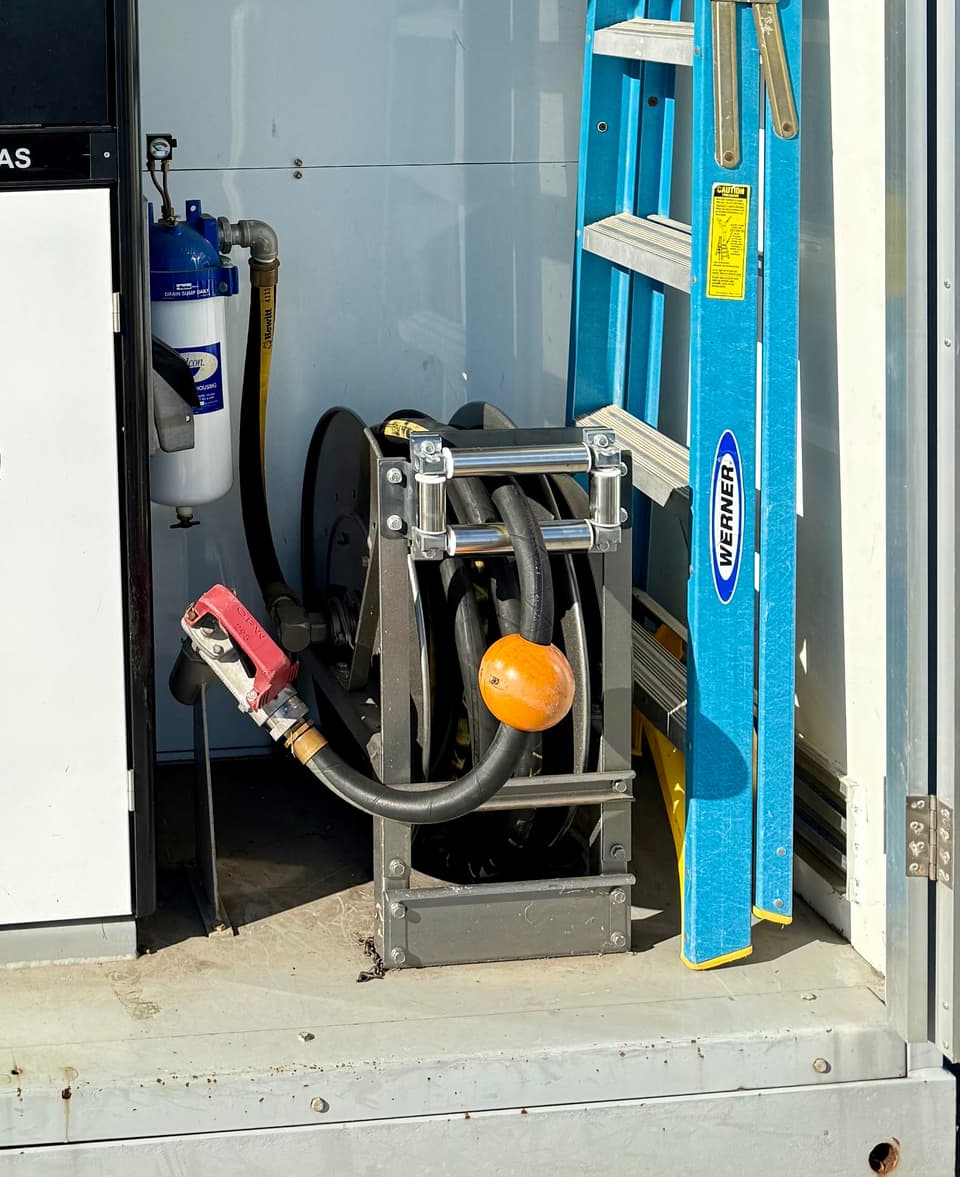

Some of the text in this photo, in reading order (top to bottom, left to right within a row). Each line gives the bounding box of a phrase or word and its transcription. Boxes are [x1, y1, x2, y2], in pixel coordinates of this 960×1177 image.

[716, 186, 745, 196] CAUTION
[264, 308, 272, 340] Hewitt
[720, 464, 734, 567] WERNER
